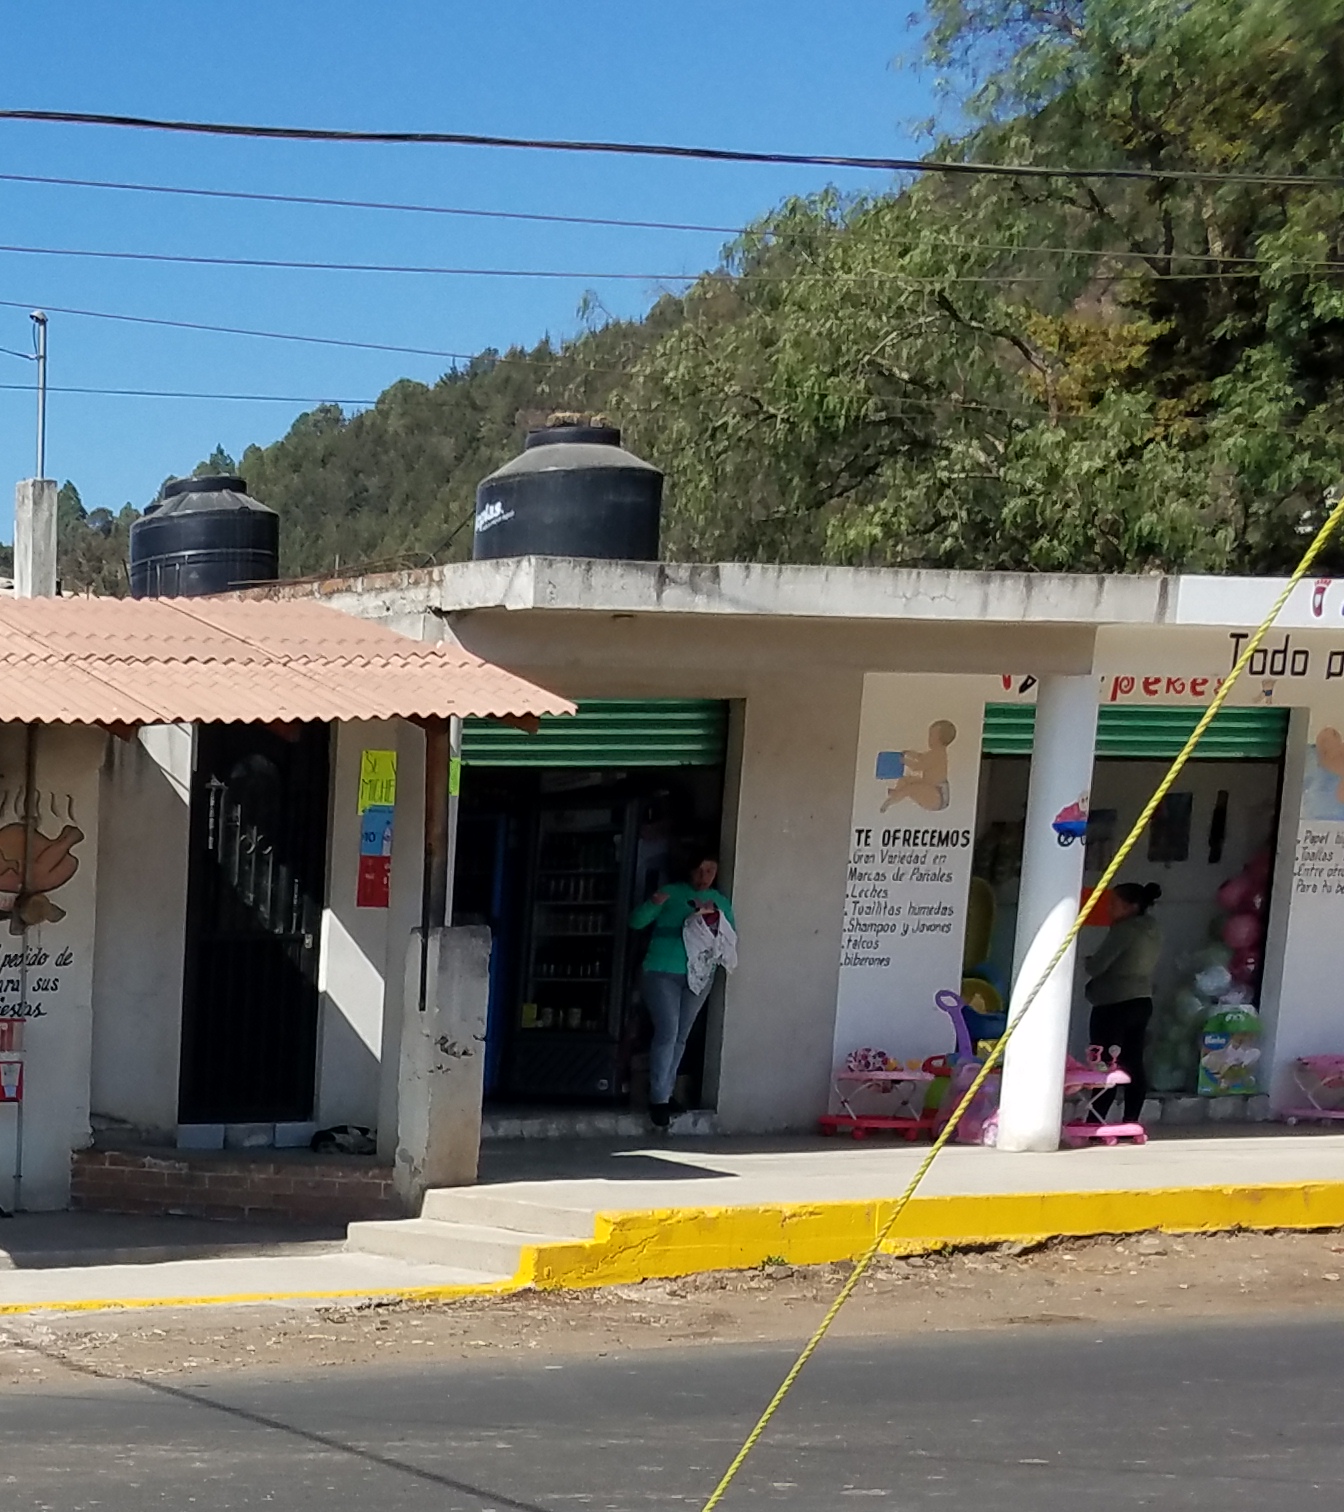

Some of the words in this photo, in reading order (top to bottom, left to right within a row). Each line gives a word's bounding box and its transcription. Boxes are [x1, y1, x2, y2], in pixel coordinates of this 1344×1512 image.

[1229, 633, 1310, 676] Todo
[855, 829, 872, 847] TE
[881, 829, 970, 848] OFRECEMOS
[852, 849, 875, 865] Gran
[880, 849, 928, 866] Variedad
[848, 867, 887, 882] Marcas
[892, 867, 904, 882] de
[850, 884, 889, 899] Leches
[847, 918, 897, 937] Shampoo
[900, 922, 910, 937] y
[54, 946, 74, 967] de
[32, 978, 60, 993] sus
